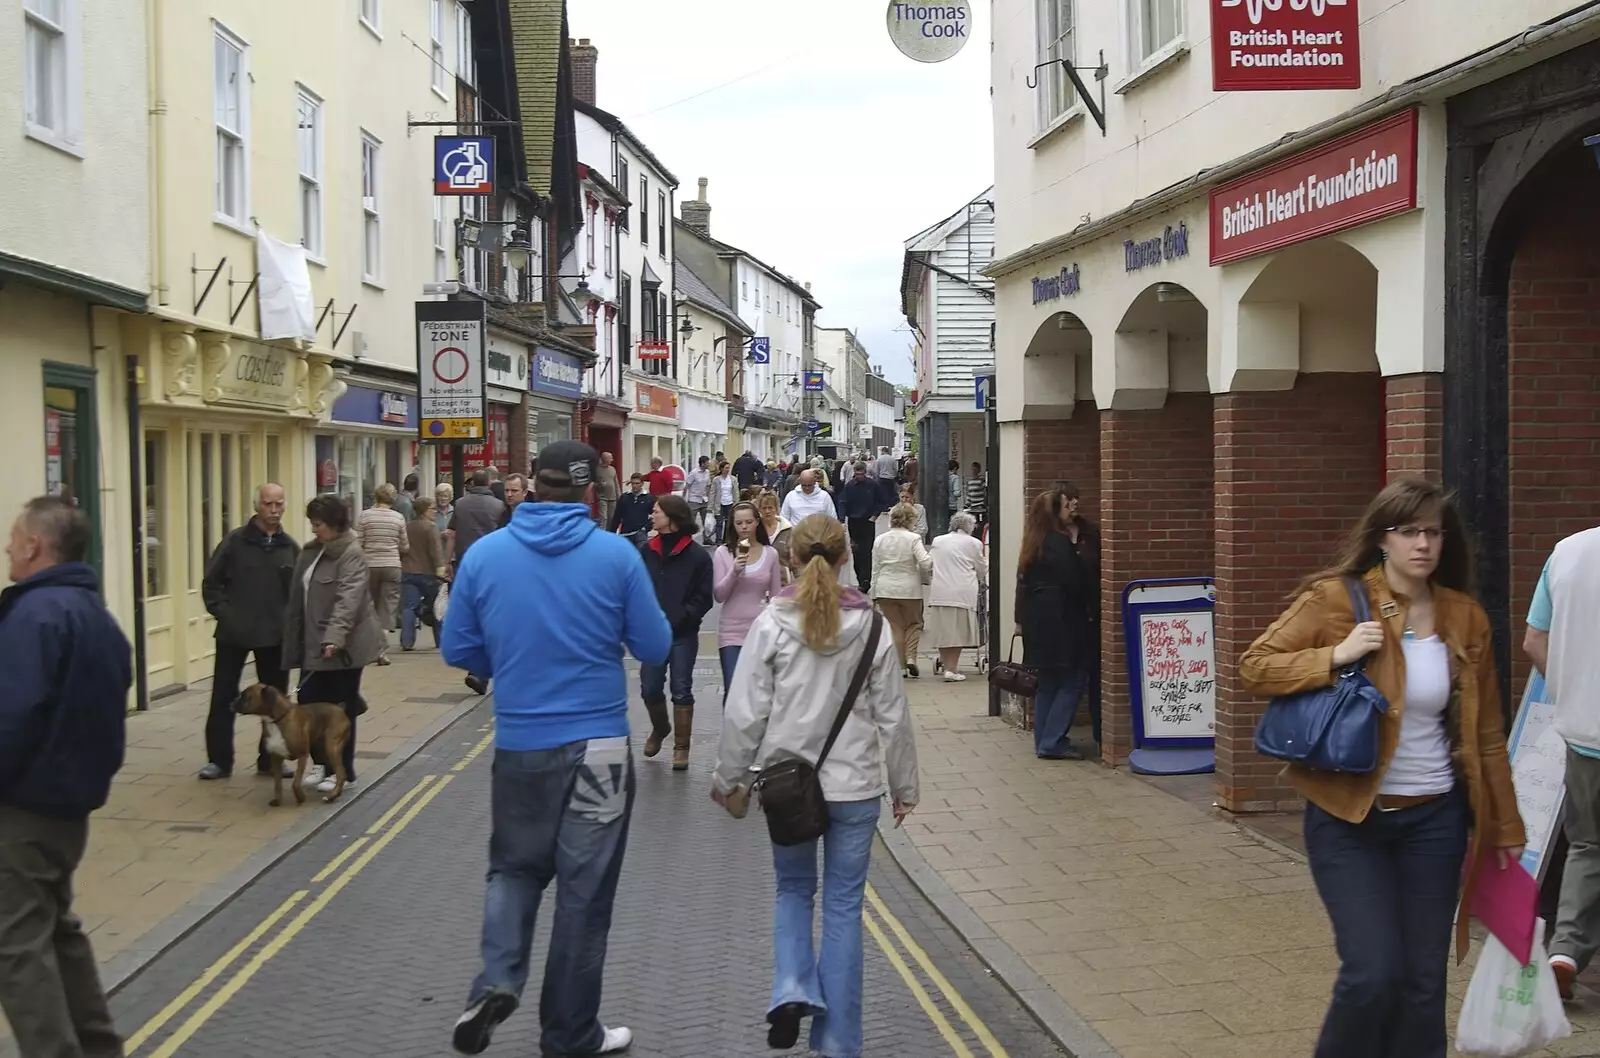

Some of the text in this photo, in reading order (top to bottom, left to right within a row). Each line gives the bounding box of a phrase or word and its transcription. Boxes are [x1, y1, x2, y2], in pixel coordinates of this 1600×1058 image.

[893, 3, 966, 20] Thomas
[921, 20, 966, 38] Cook
[1229, 29, 1343, 46] British Heart
[1230, 48, 1344, 67] Foundation
[1222, 149, 1398, 240] British Heart Foundation
[1124, 220, 1189, 273] Thomas Cook
[1031, 262, 1081, 305] Thomas Cook
[423, 322, 477, 330] PEDESTRIAN
[431, 331, 470, 342] ZONE
[1147, 659, 1188, 680] SUMMER
